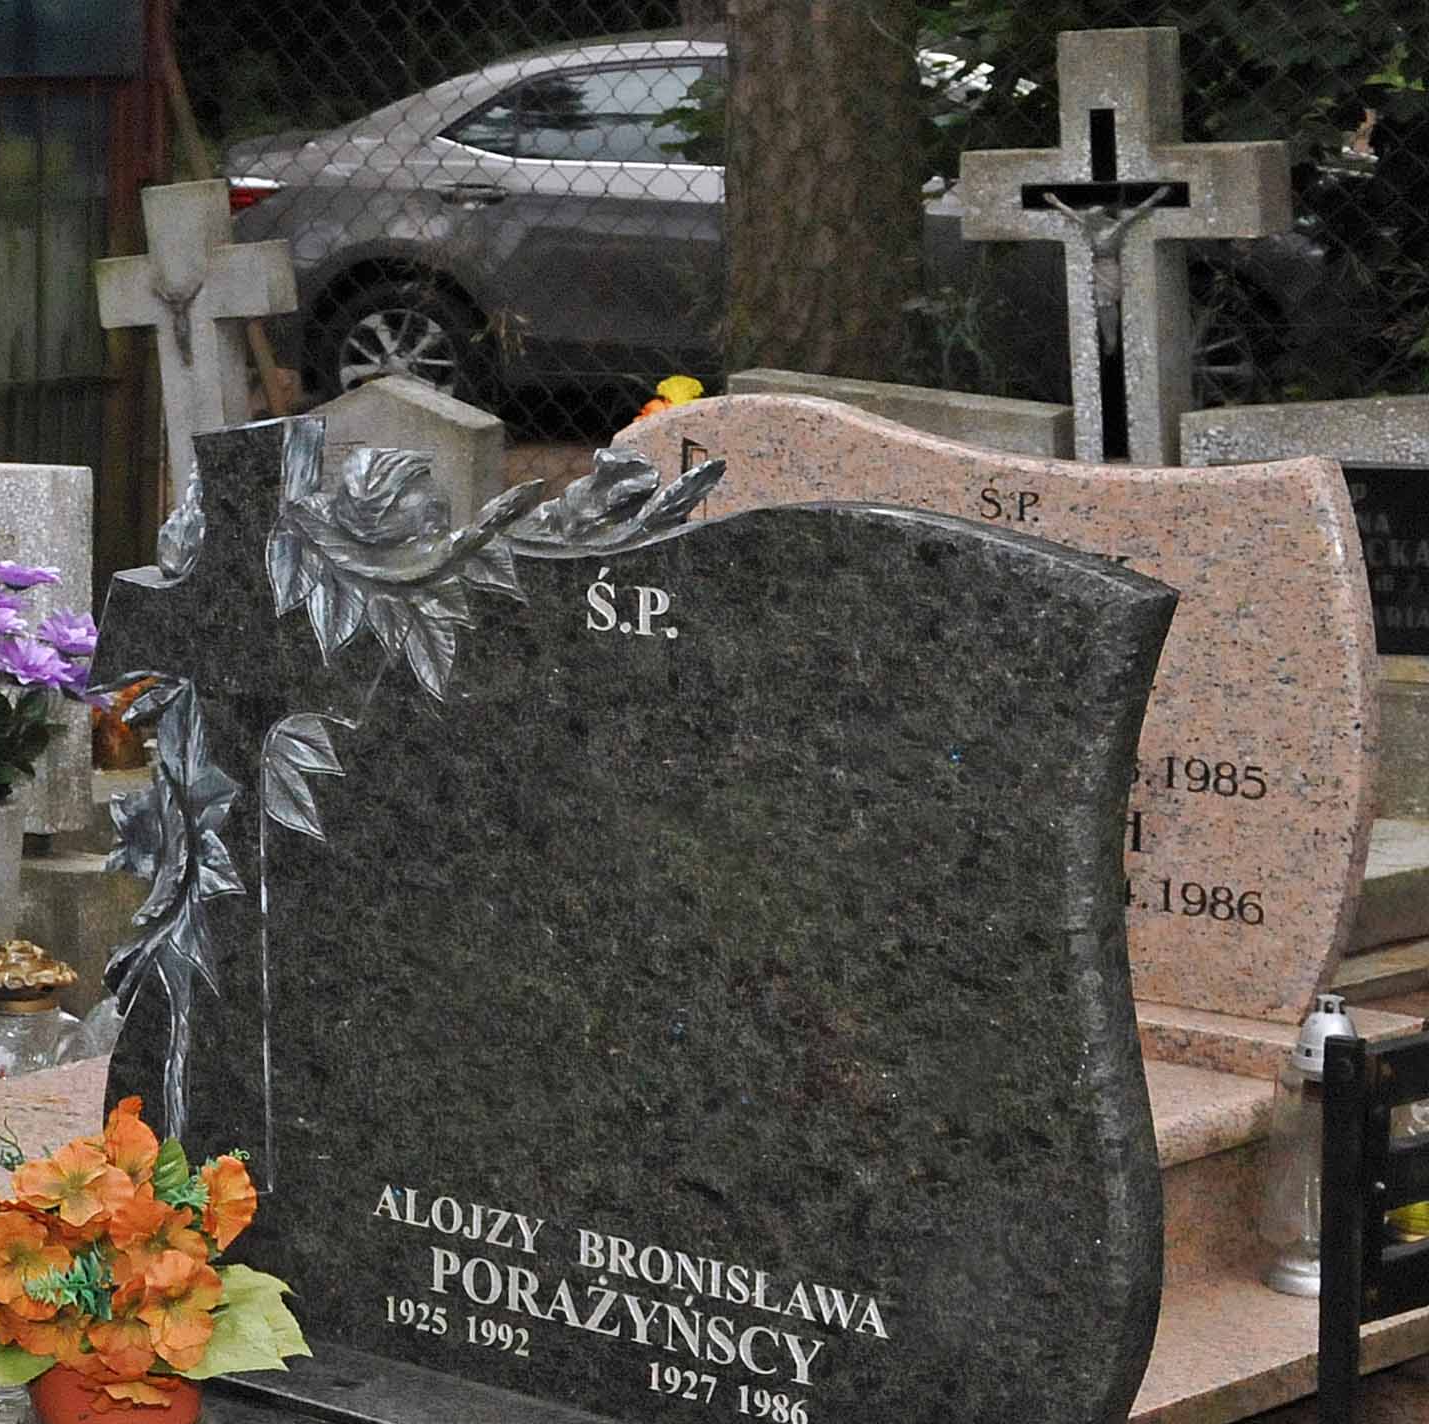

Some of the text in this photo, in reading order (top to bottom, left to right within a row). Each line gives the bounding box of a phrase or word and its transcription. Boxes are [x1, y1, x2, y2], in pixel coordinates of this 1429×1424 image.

[587, 566, 679, 639] Ś.P.
[373, 1184, 889, 1339] ALOJZY BRONISŁAWA
[384, 1295, 531, 1358] 1925 1992
[429, 1246, 825, 1386] PORAŻYŃSCY
[648, 1361, 718, 1405] 1927
